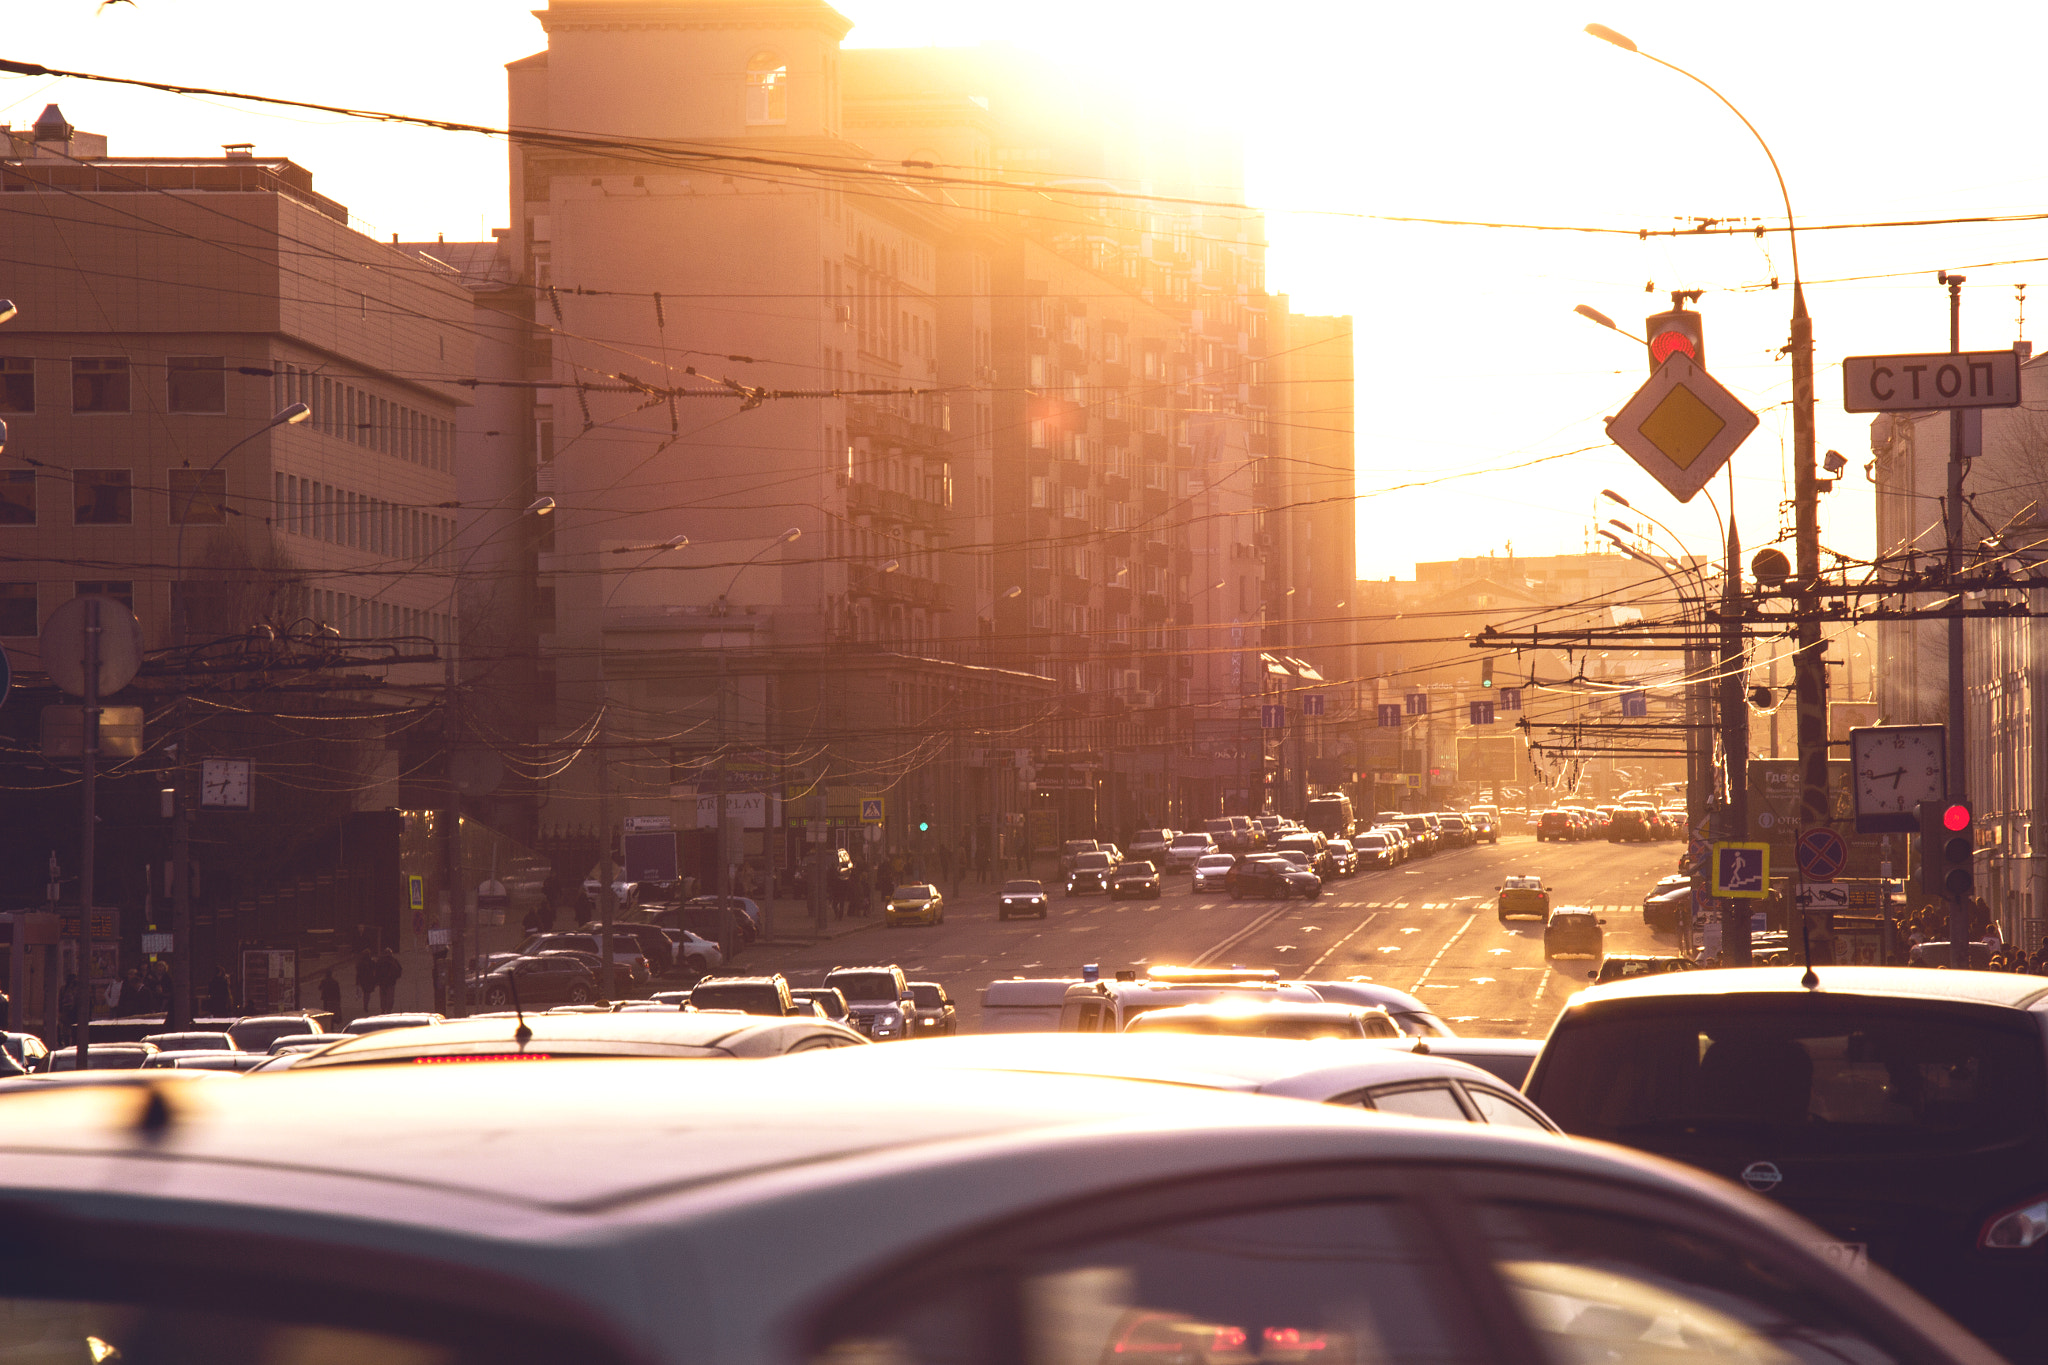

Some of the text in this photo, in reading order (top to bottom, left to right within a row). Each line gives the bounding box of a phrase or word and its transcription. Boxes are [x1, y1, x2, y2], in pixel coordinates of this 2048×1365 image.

[1870, 361, 1994, 401] СТОП
[1893, 740, 1905, 749] 12
[1866, 769, 1874, 779] 9
[1926, 767, 1933, 776] 3
[1765, 771, 1788, 784] Где
[696, 798, 762, 810] ARPLAY
[1897, 796, 1904, 805] 6
[1777, 816, 1800, 825] ОТК
